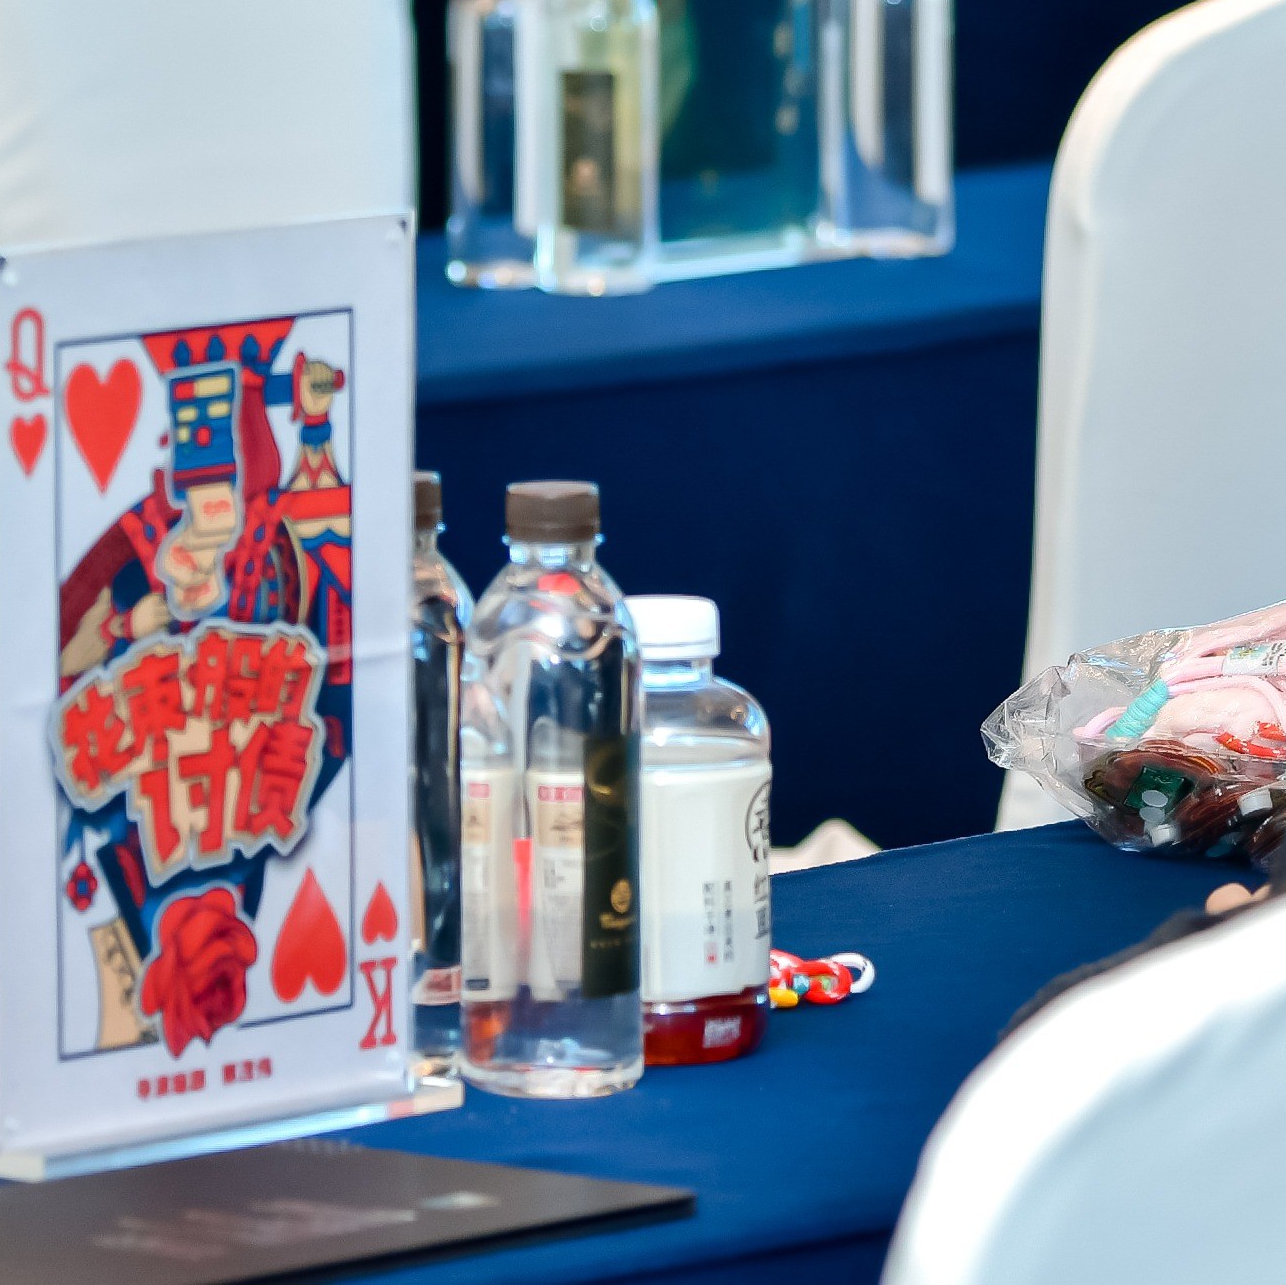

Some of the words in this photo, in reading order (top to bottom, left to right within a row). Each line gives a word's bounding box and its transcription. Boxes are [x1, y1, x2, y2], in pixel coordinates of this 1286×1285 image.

[5, 307, 52, 402] Q
[139, 719, 315, 863] 讨债
[359, 957, 397, 1050] K
